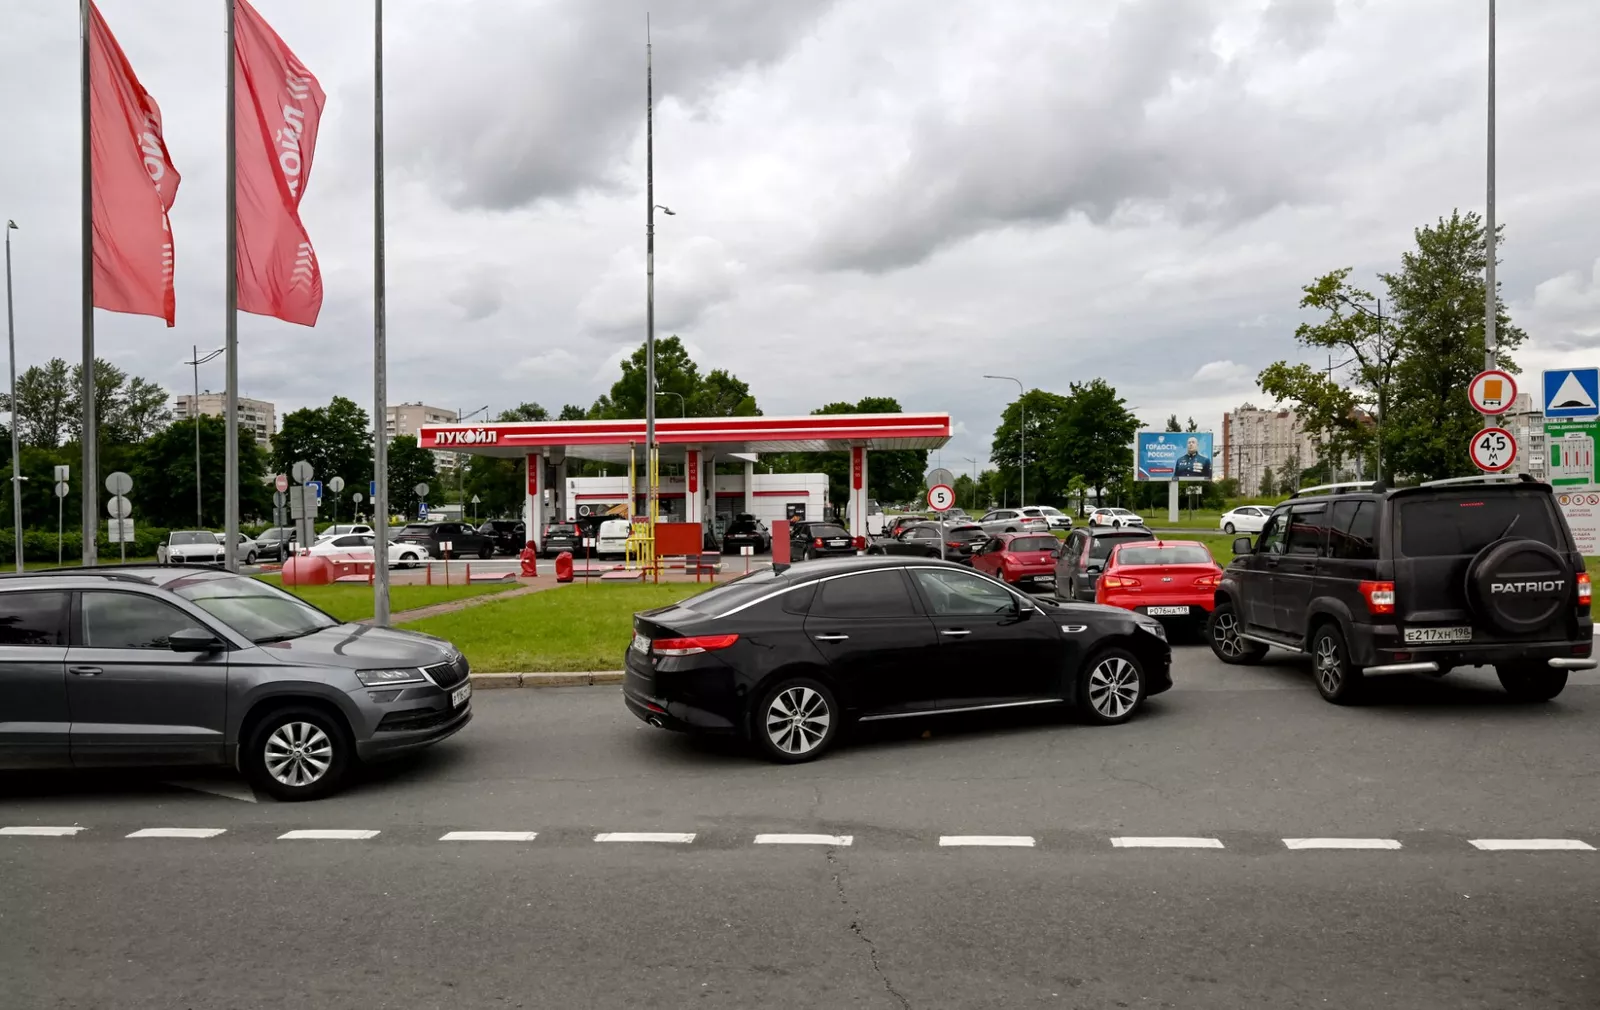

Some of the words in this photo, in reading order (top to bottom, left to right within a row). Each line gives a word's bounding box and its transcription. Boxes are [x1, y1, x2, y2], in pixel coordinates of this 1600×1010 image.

[434, 428, 497, 444] ЛУКОЙЛ
[1480, 436, 1506, 452] 4,5
[937, 492, 945, 503] 5
[1491, 580, 1565, 594] PATRIOT
[1408, 629, 1451, 640] Е217ХН
